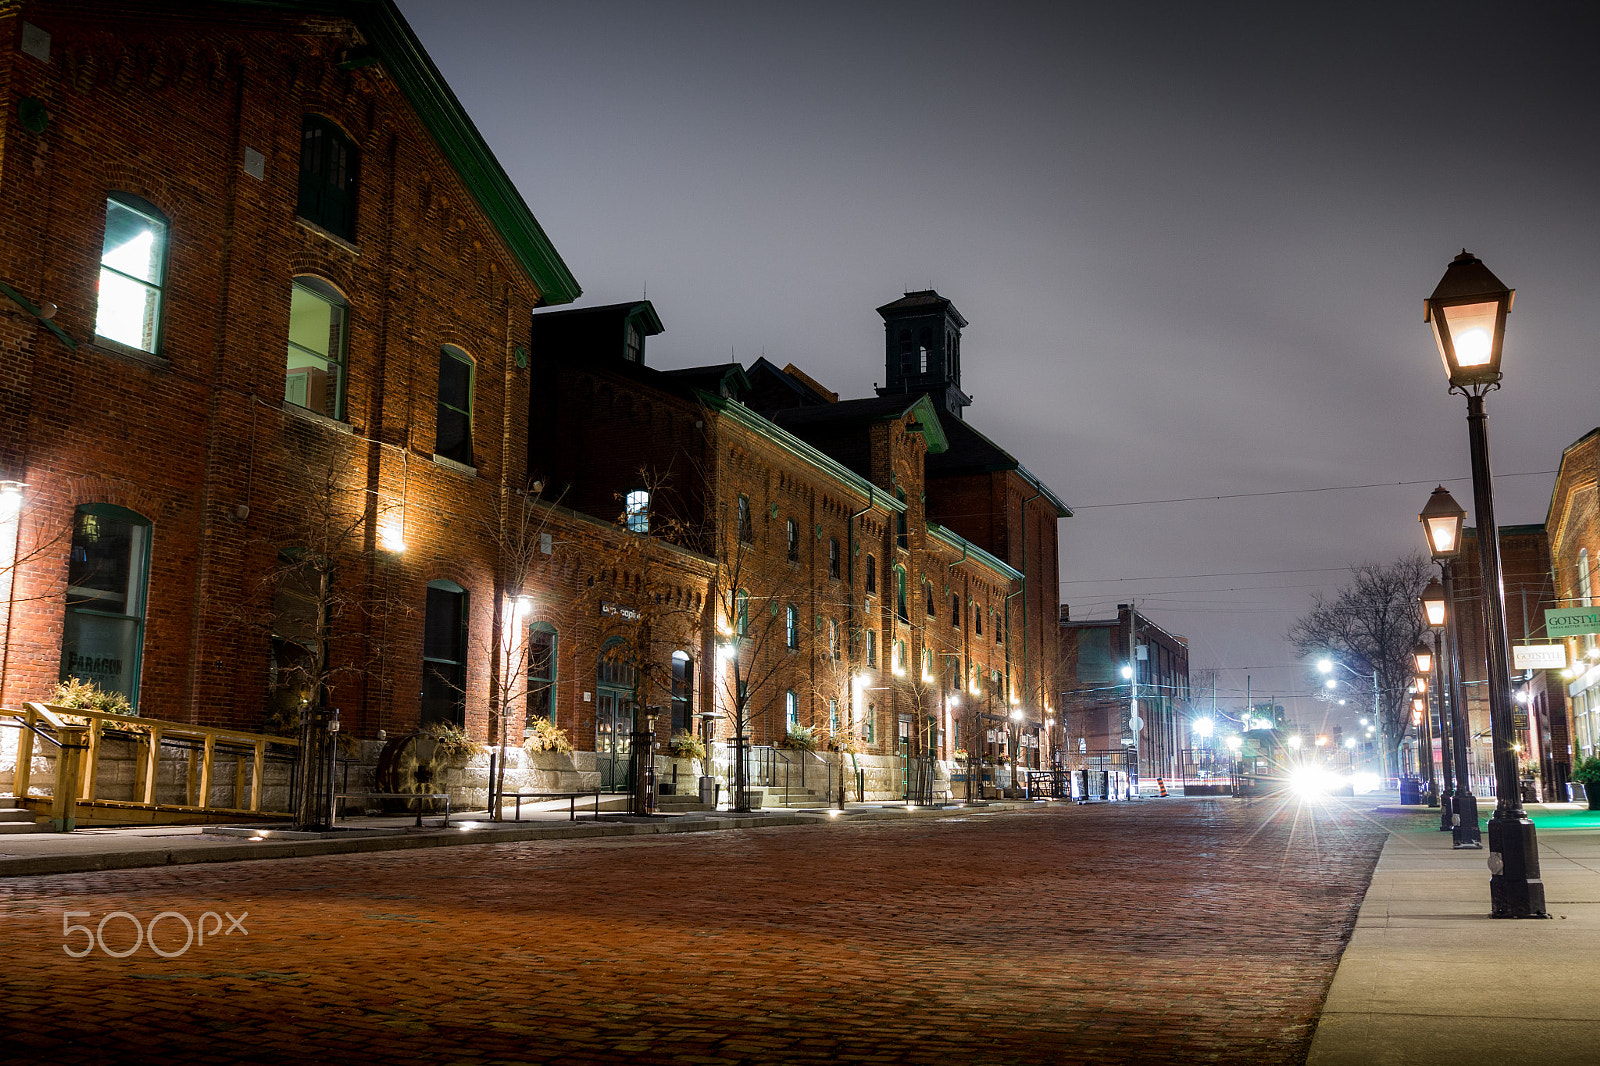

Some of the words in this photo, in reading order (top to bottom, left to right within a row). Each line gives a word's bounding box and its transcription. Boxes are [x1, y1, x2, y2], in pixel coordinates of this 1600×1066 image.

[1549, 614, 1600, 625] GOTSTYL
[1516, 651, 1562, 660] GOTSTYLE
[67, 651, 122, 675] PARAGON
